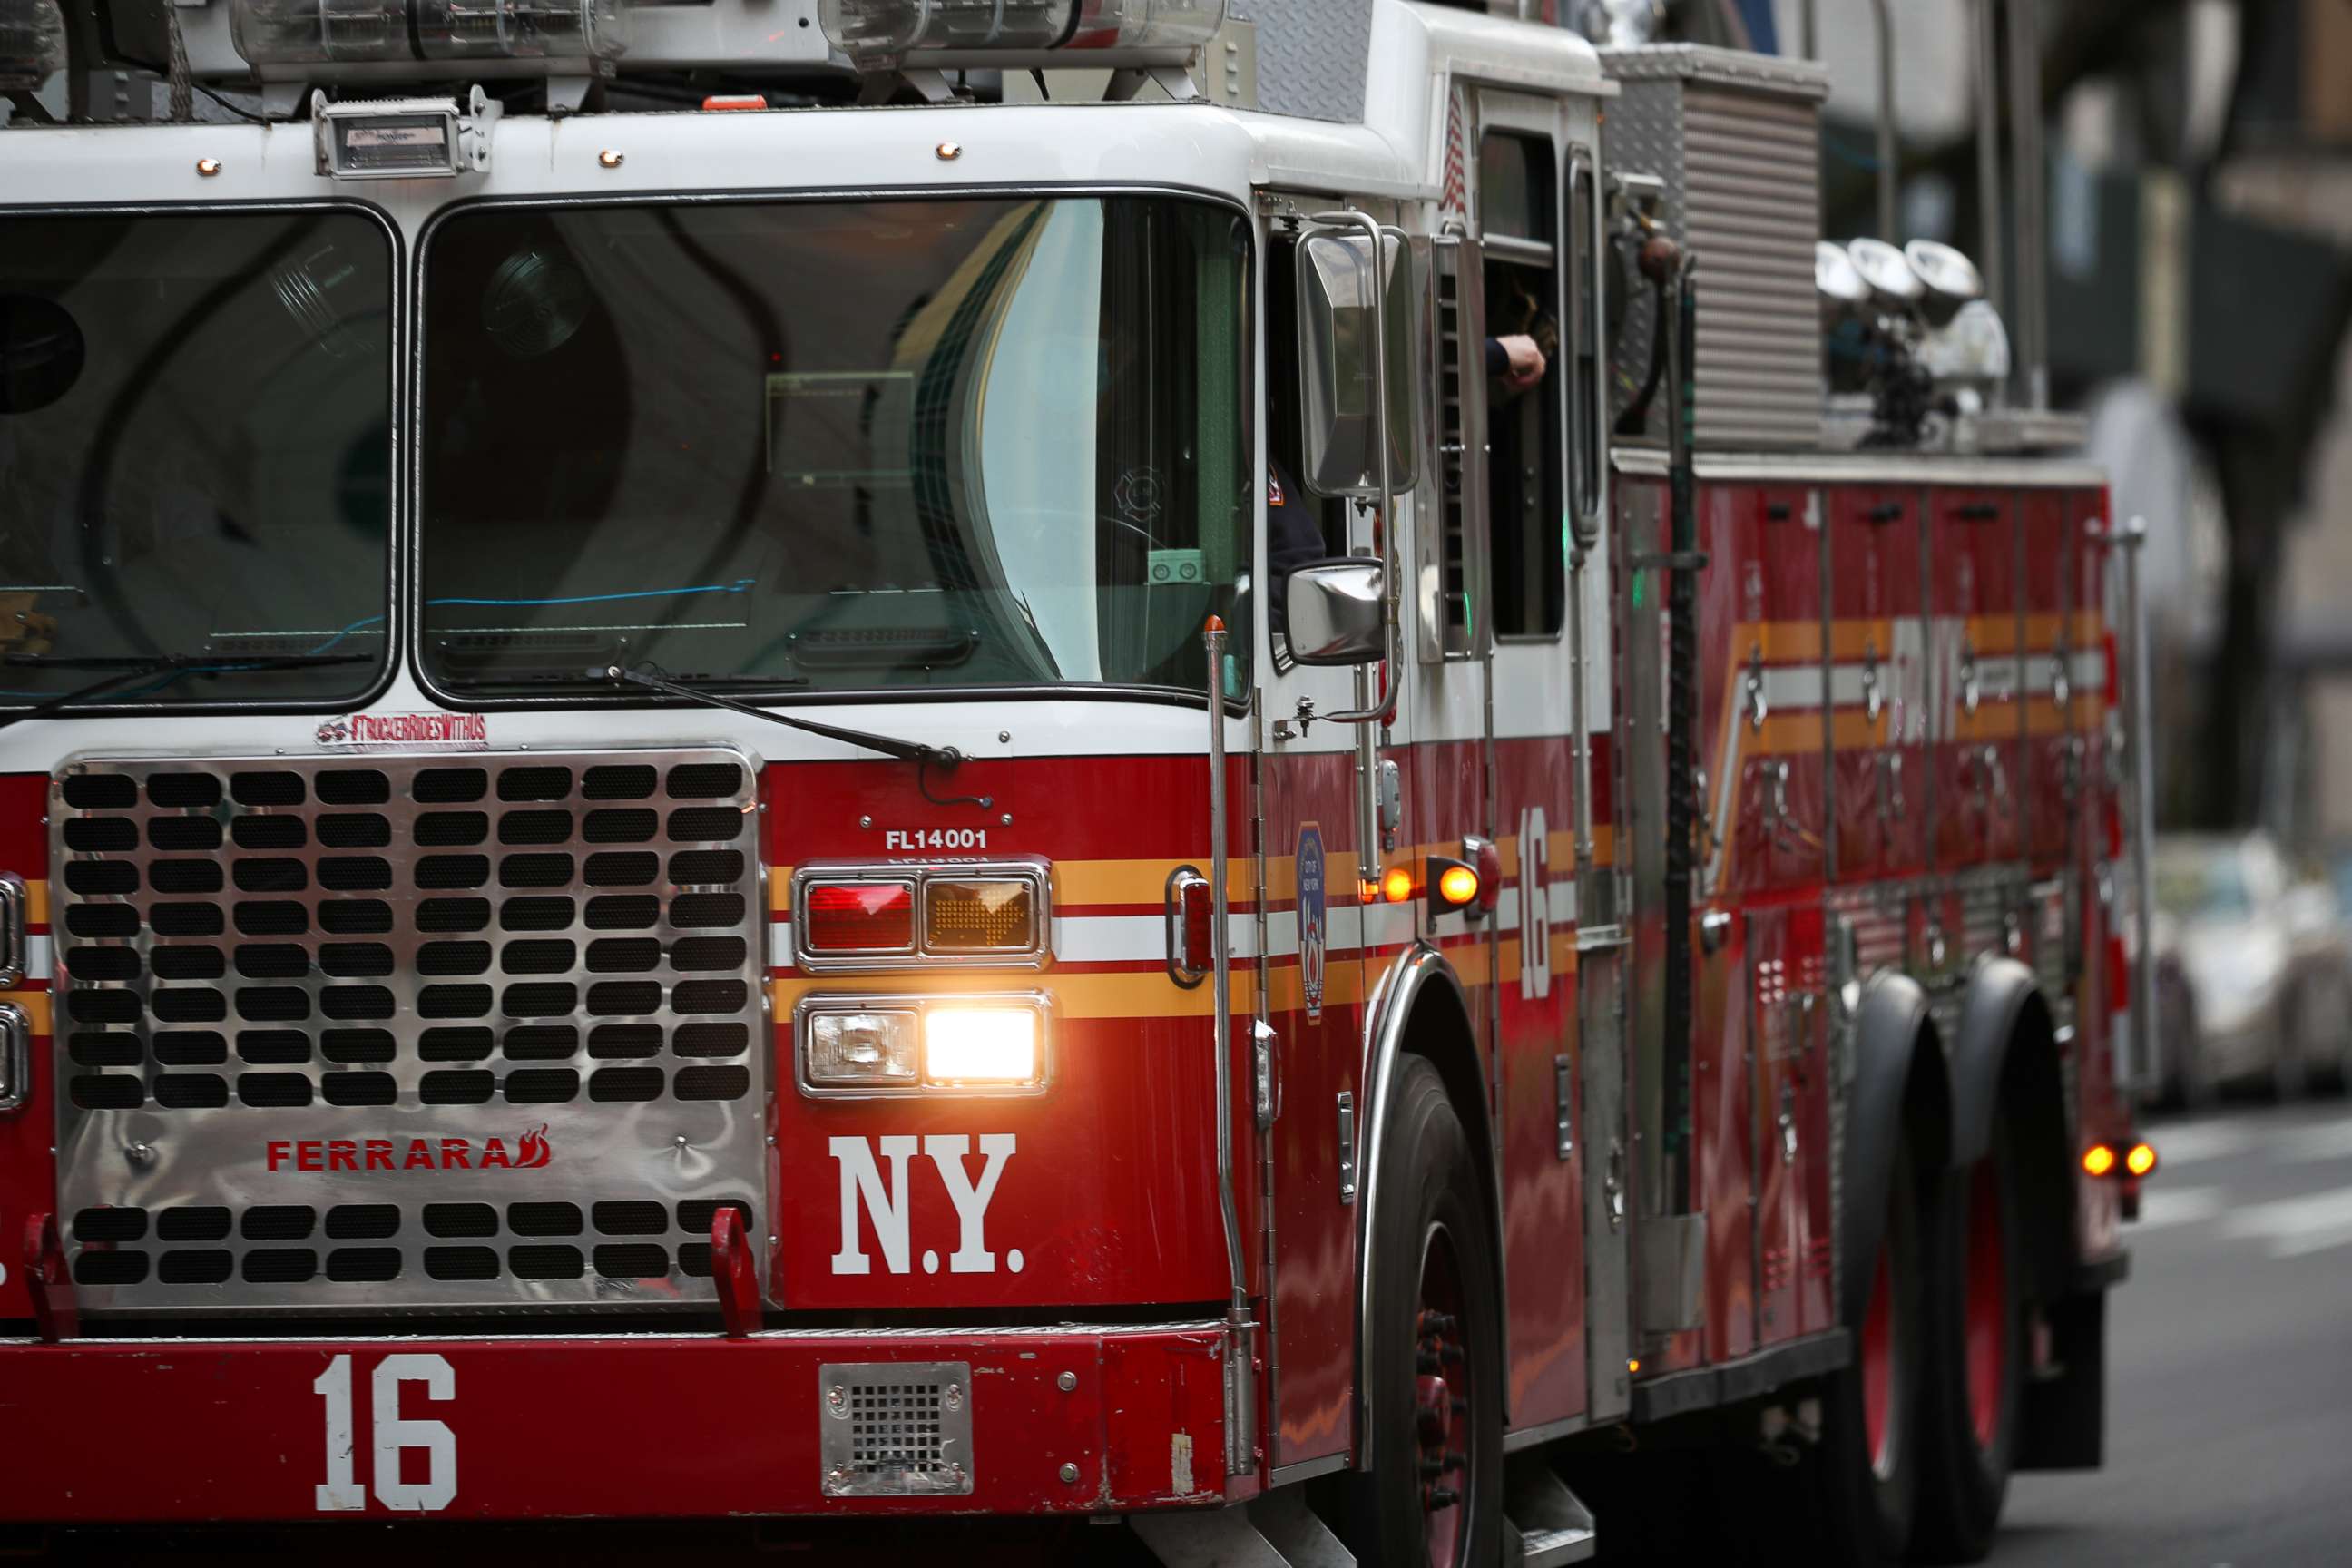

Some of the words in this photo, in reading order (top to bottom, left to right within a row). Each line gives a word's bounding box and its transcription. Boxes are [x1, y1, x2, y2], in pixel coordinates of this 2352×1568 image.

[886, 828, 986, 850] FL14001
[1518, 806, 1551, 1000] 16
[267, 1138, 511, 1172] FERRARA
[829, 1133, 1024, 1274] N.Y.
[313, 1353, 457, 1511] 16
